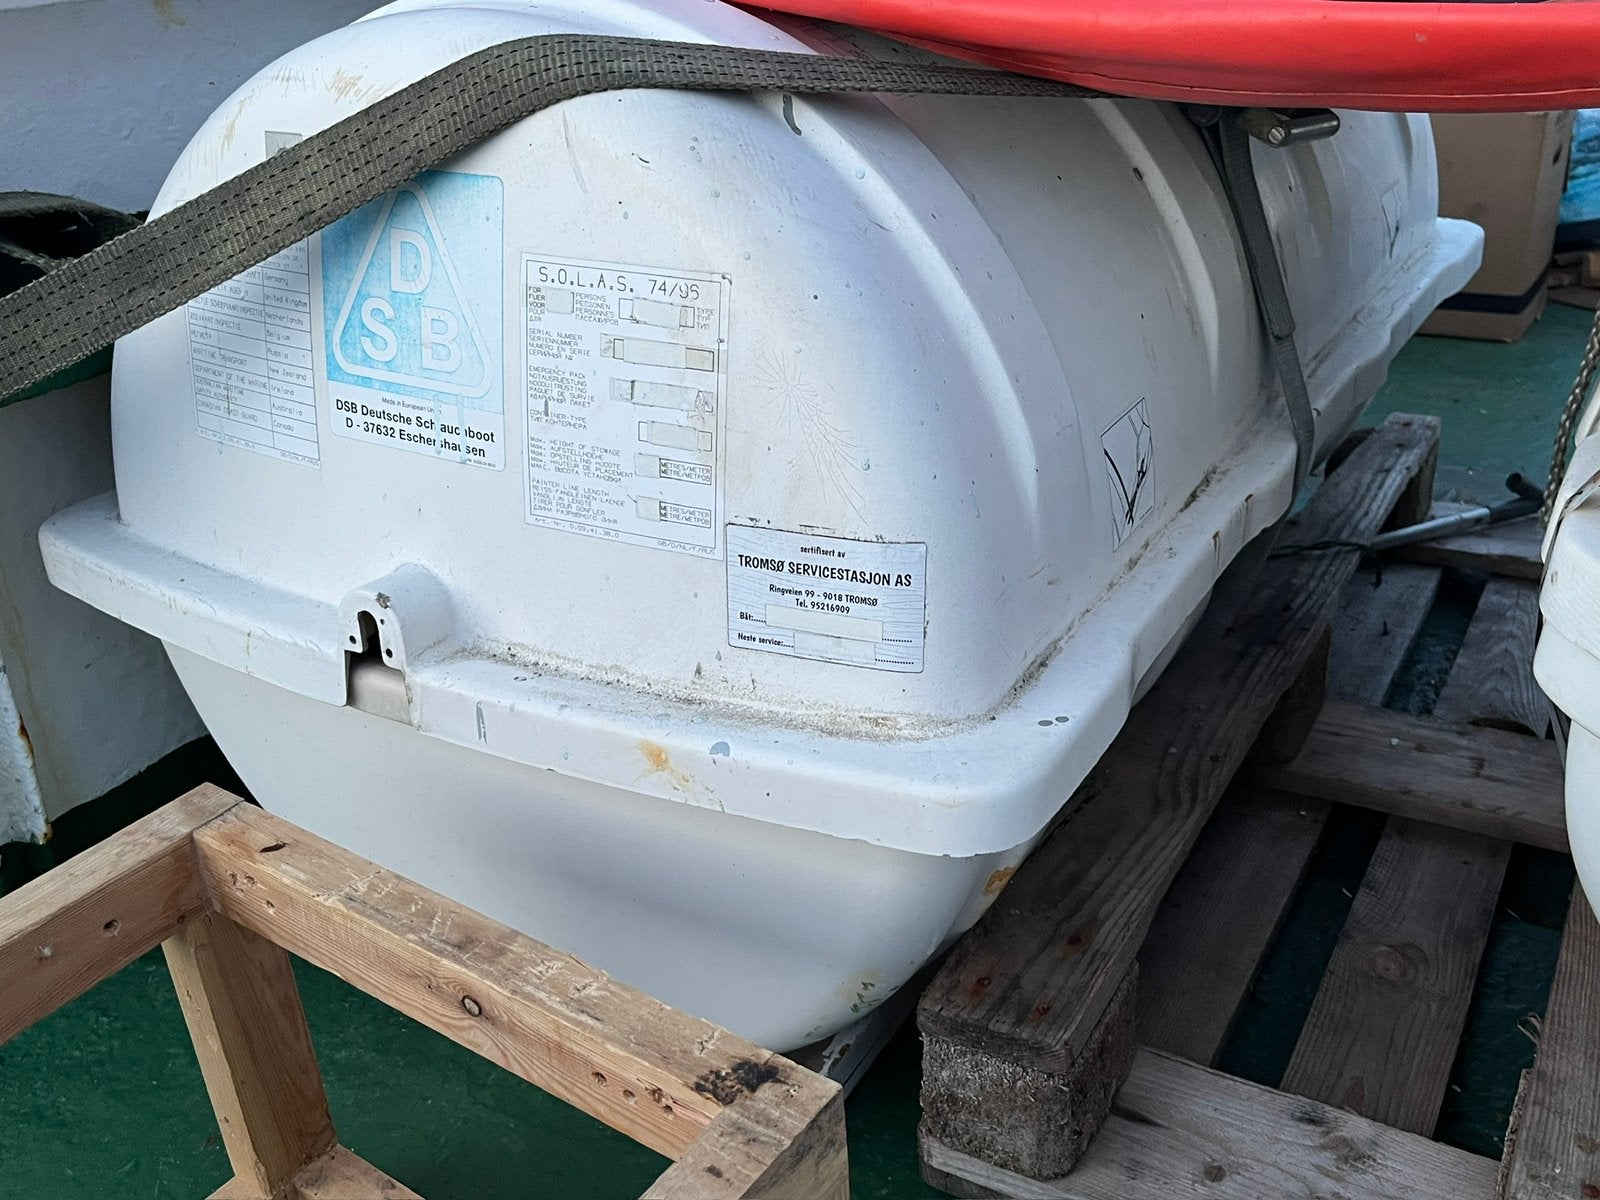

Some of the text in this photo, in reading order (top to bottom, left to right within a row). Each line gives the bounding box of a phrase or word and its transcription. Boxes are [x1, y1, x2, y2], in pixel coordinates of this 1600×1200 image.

[390, 226, 432, 294] D
[539, 266, 634, 293] S.O.L.A.S.
[576, 292, 606, 302] PERSONS
[576, 307, 614, 318] PERSONNES
[266, 330, 290, 340] Belgium
[360, 296, 462, 373] S B
[529, 328, 583, 341] SERIAL NUMBER
[529, 335, 578, 346] SERIENNUMMER
[569, 348, 591, 357] SERIE
[282, 368, 306, 380] Zealand
[529, 365, 586, 380] EMERGENCY PACK
[382, 397, 396, 406] Made
[402, 401, 426, 412] European
[336, 398, 358, 414] DSB
[361, 404, 412, 425] Deutsche
[416, 416, 495, 443] Schaucboot
[530, 409, 587, 424] CONTINER-TYPE
[346, 417, 354, 428] D
[363, 422, 396, 438] 37632
[550, 440, 574, 448] HEIGHT
[596, 467, 633, 478] PLACEMENT
[532, 478, 560, 488] PAINTER
[584, 488, 609, 497] LENGTH
[800, 546, 835, 557] sertifisert
[738, 554, 912, 587] TROMSØ SERVICESTASJON AS
[769, 584, 803, 596] Ringveien
[804, 590, 814, 598] 99
[823, 592, 843, 602] 9018
[845, 595, 878, 607] TROMSØ
[795, 599, 850, 614] Tel. 95216909
[738, 633, 757, 642] Neste
